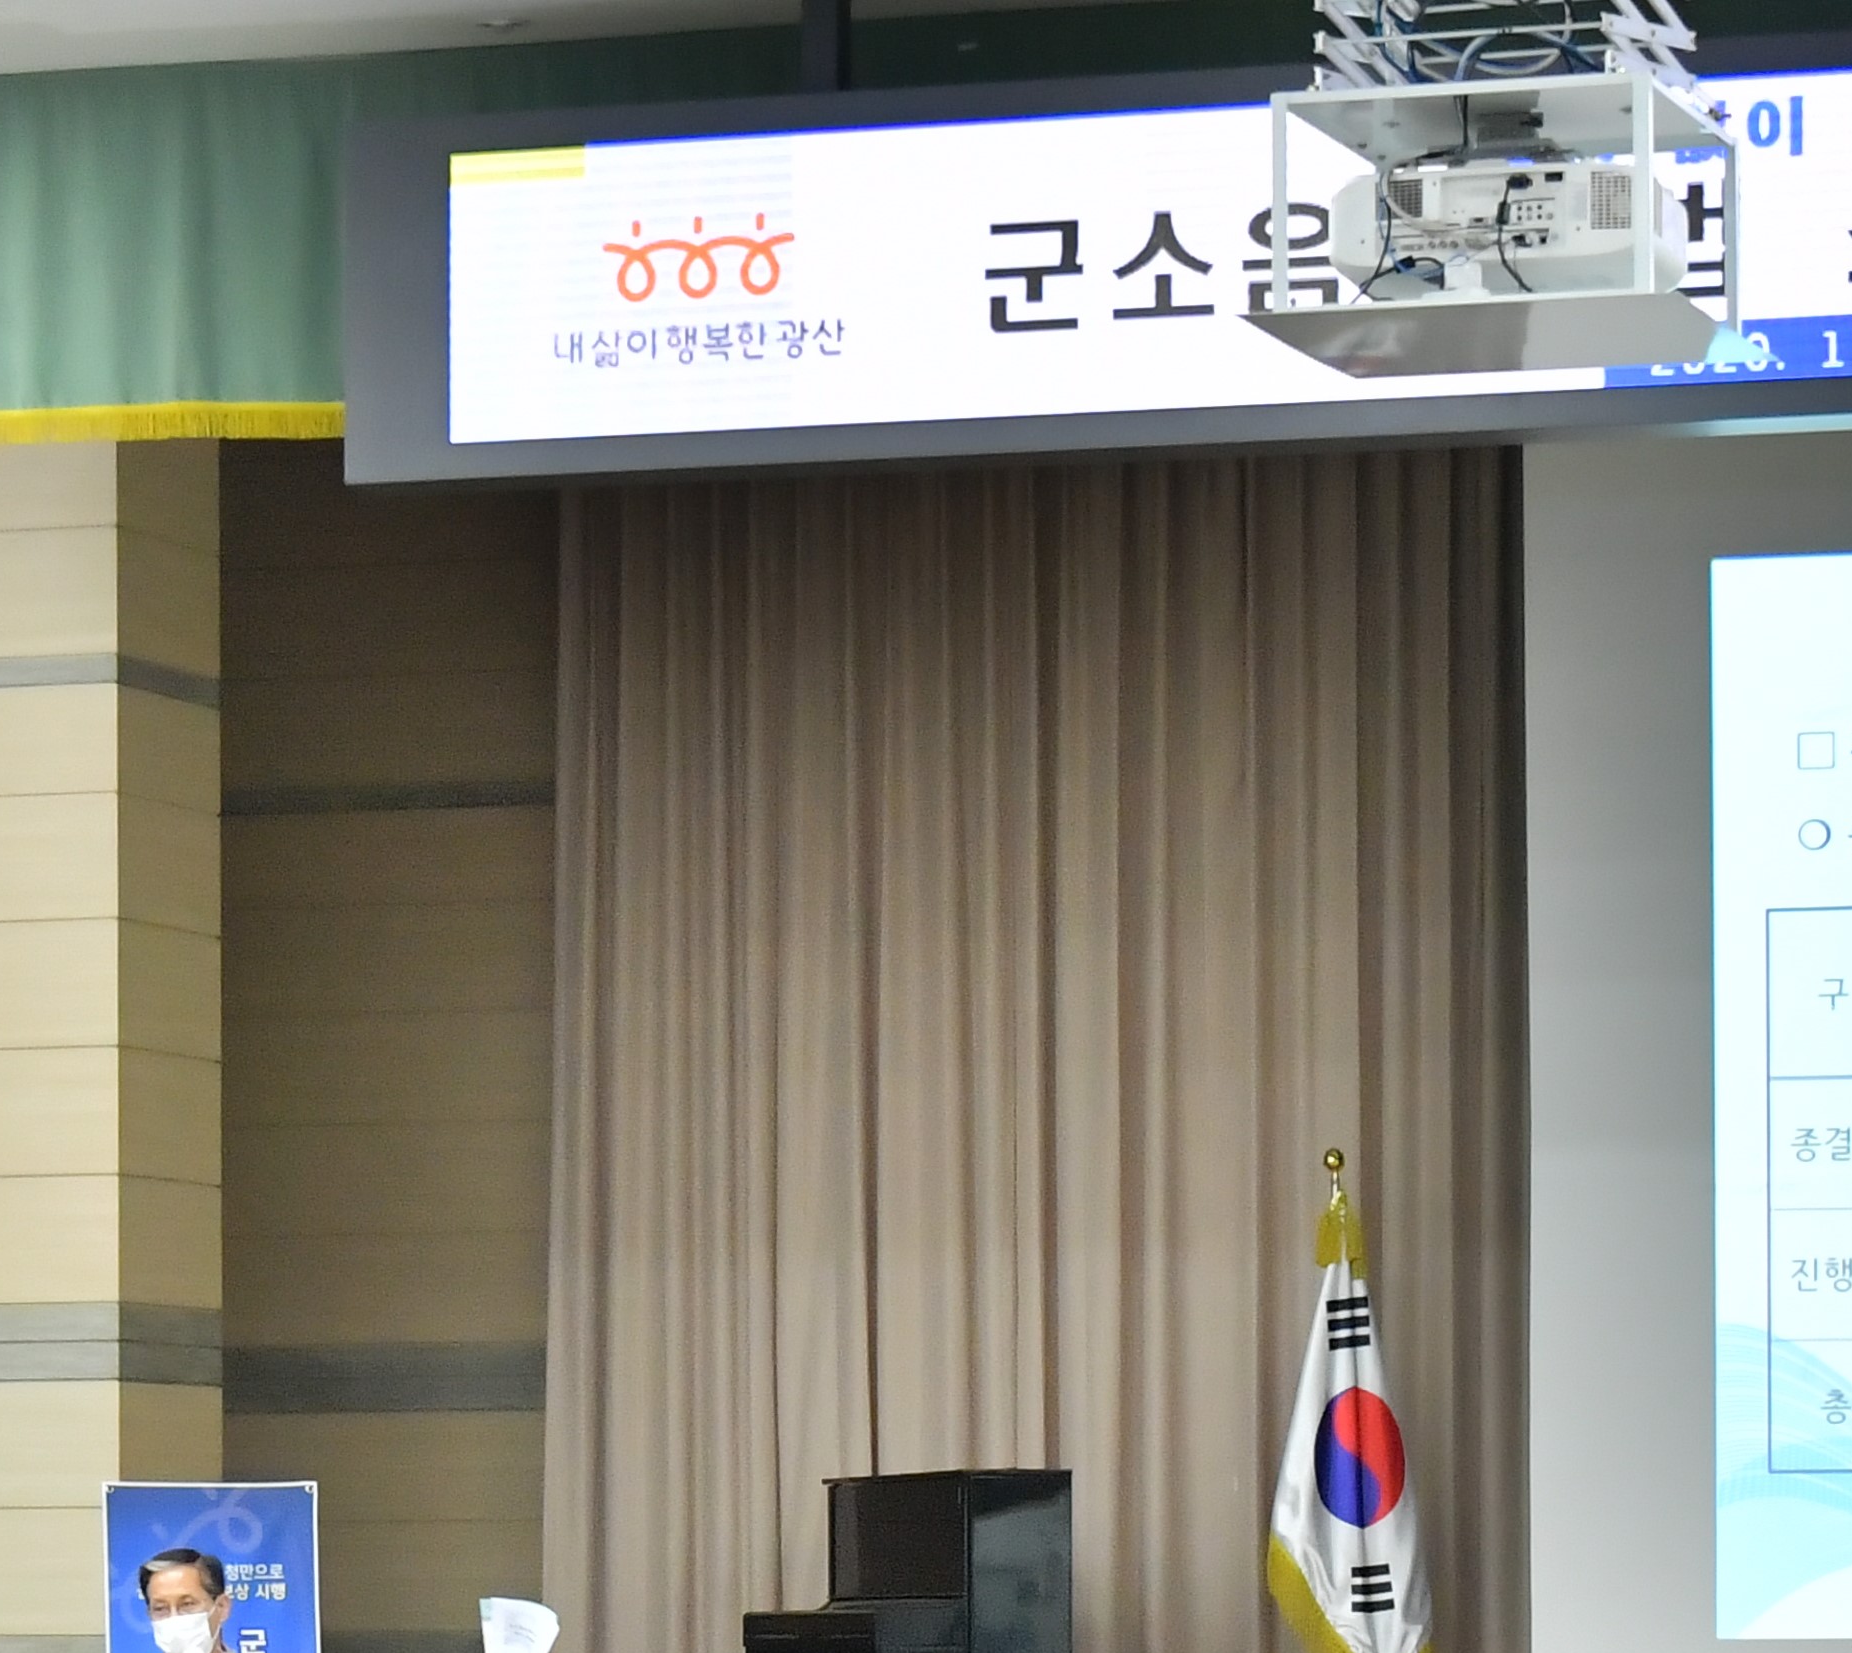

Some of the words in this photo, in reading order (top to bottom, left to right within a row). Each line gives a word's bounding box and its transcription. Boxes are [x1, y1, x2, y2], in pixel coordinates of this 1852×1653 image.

[1820, 1388, 1852, 1425] 총
[224, 1563, 285, 1582] 청만으로
[224, 1563, 285, 1582] 청만으로
[254, 1582, 287, 1601] 시행
